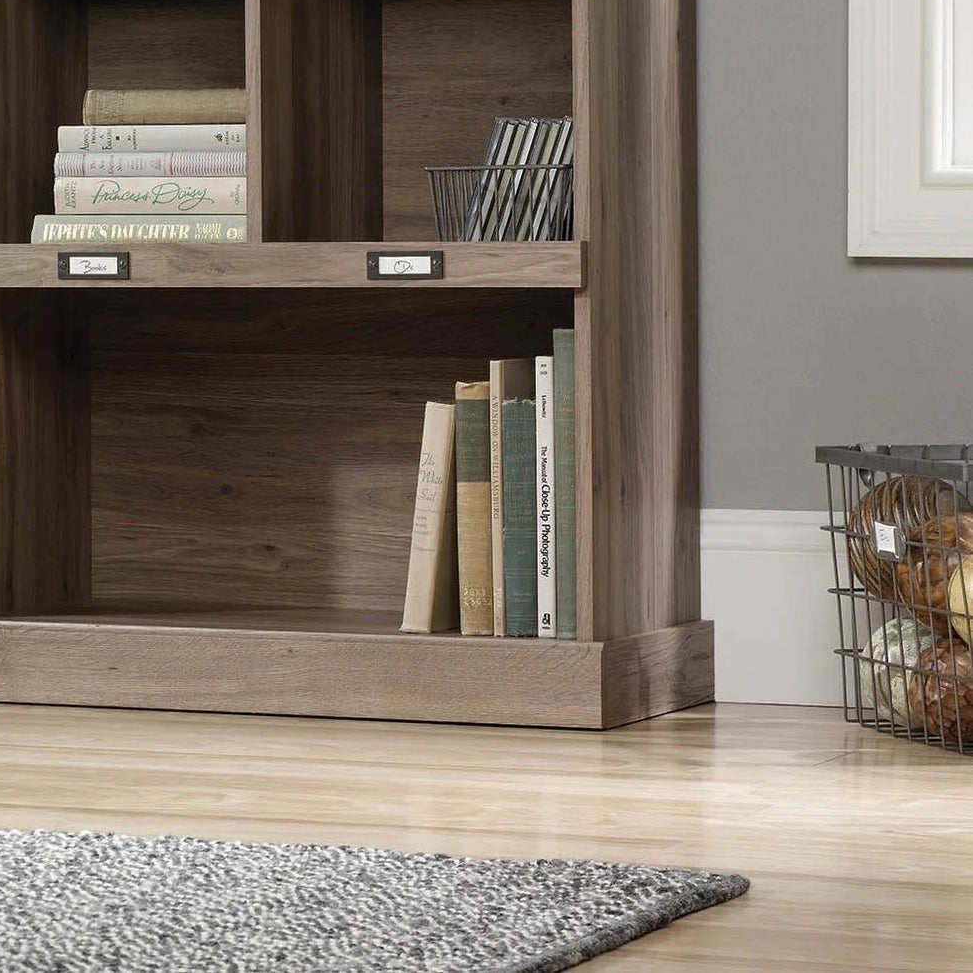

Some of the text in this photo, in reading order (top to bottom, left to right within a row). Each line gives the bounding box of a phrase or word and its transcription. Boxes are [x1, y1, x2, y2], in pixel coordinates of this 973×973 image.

[93, 180, 214, 211] Princess Daisy
[111, 222, 189, 241] DAUGHTER
[79, 259, 107, 274] Books
[491, 402, 499, 438] WINDOW
[492, 440, 499, 453] ON
[491, 455, 500, 519] WILLIAMSBURG
[540, 484, 551, 522] Close-Up
[540, 524, 552, 578] Photography
